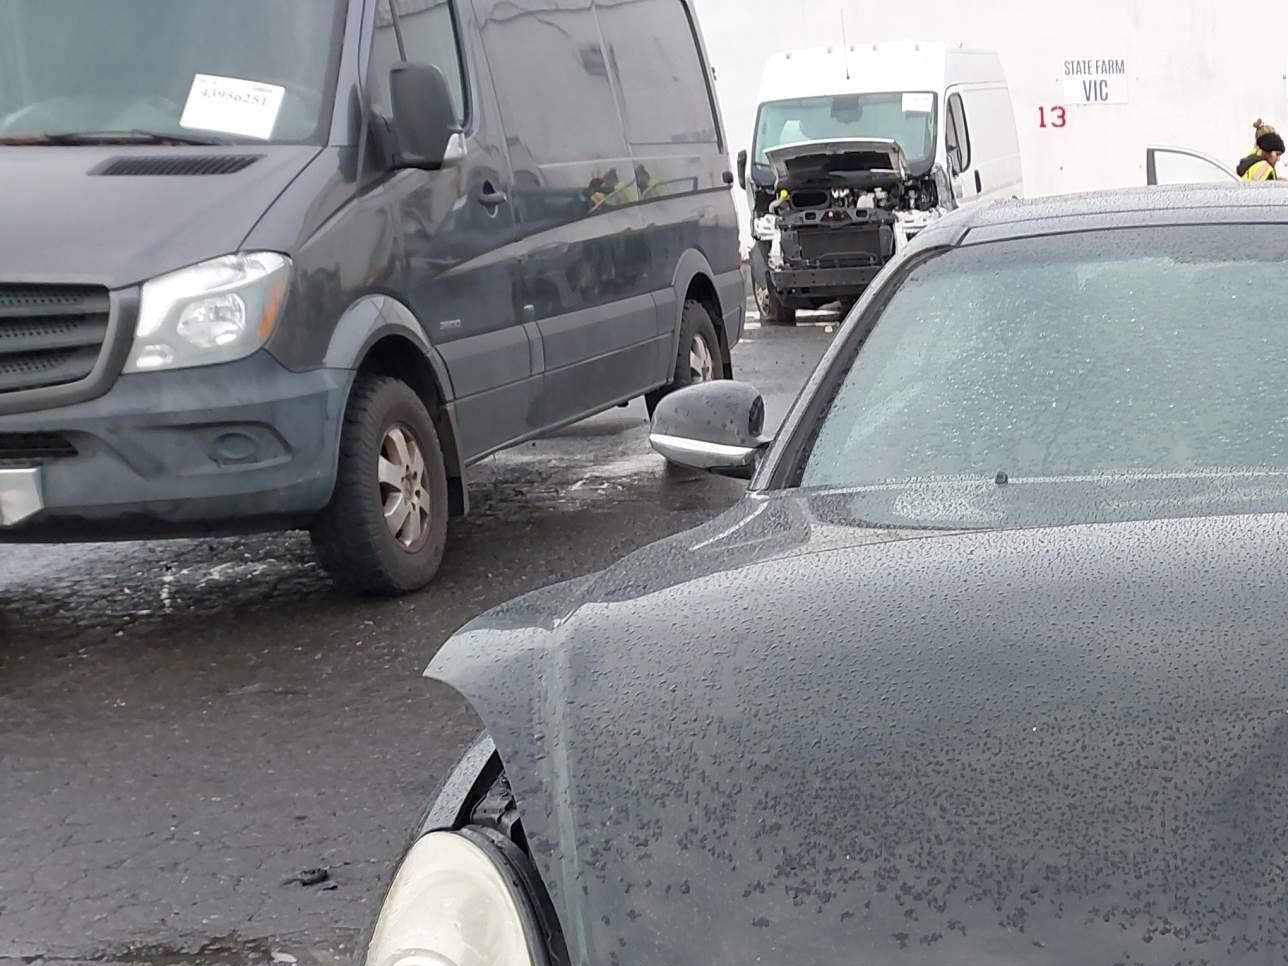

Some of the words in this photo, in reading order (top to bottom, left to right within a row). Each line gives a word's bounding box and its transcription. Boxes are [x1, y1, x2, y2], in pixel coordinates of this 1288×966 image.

[1064, 59, 1094, 76] STATE
[1096, 58, 1125, 75] FARM
[1082, 79, 1109, 102] VIC
[1038, 106, 1067, 128] 13
